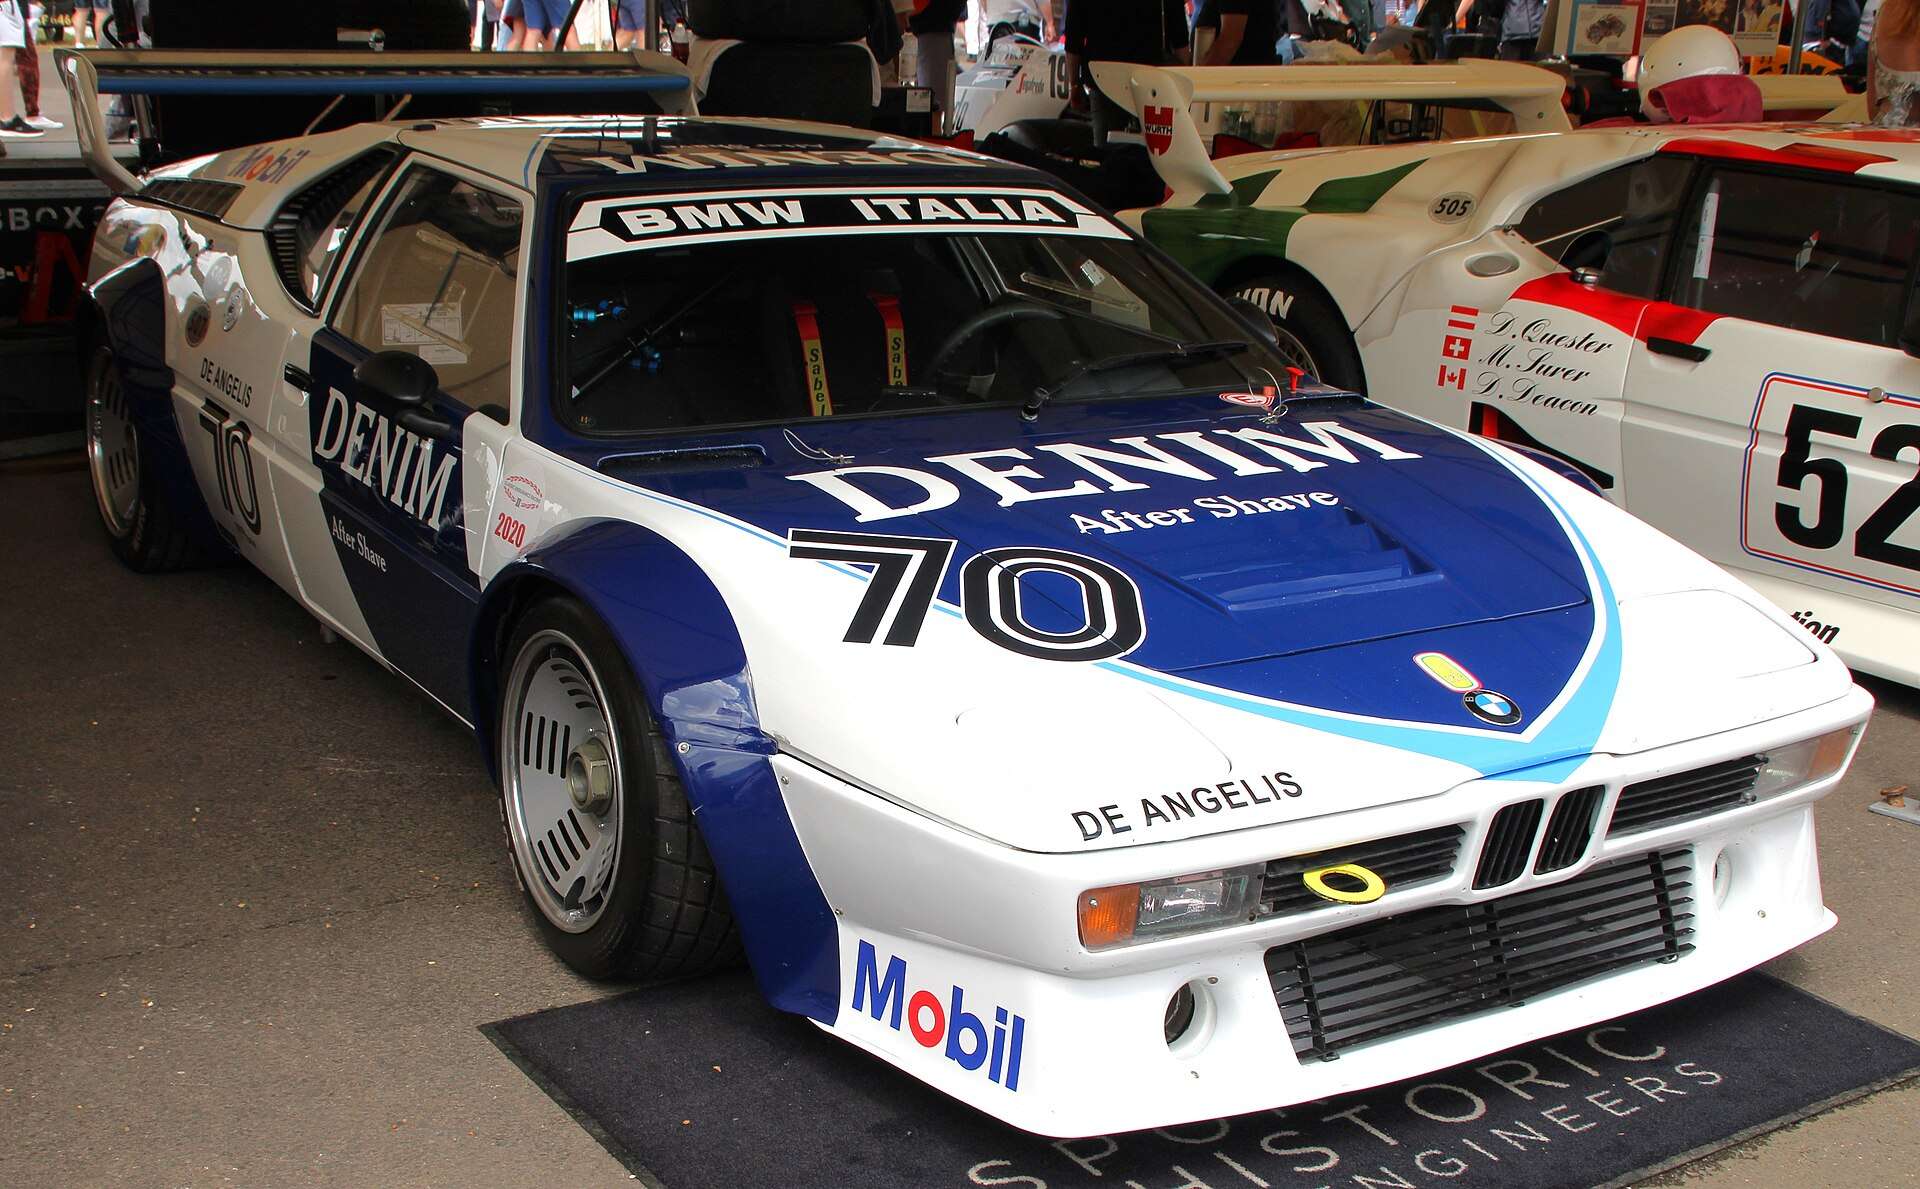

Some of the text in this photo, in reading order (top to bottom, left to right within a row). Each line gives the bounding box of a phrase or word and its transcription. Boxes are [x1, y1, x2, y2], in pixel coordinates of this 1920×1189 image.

[1048, 54, 1070, 100] 19
[228, 146, 311, 184] Mobil
[617, 198, 1067, 236] BMW ITALIA
[1435, 198, 1471, 217] 505
[200, 357, 253, 409] DE ANGELIS
[199, 397, 262, 536] 70
[315, 386, 458, 532] DENIM
[785, 420, 1423, 523] DENIM
[495, 512, 526, 548] 2020
[1069, 491, 1340, 535] After Shave
[331, 515, 387, 573] After Shave
[787, 527, 1148, 663] 70
[1071, 771, 1303, 842] DE ANGELIS
[851, 938, 1026, 1093] Mobil
[1322, 1062, 1723, 1189] NGINEERS
